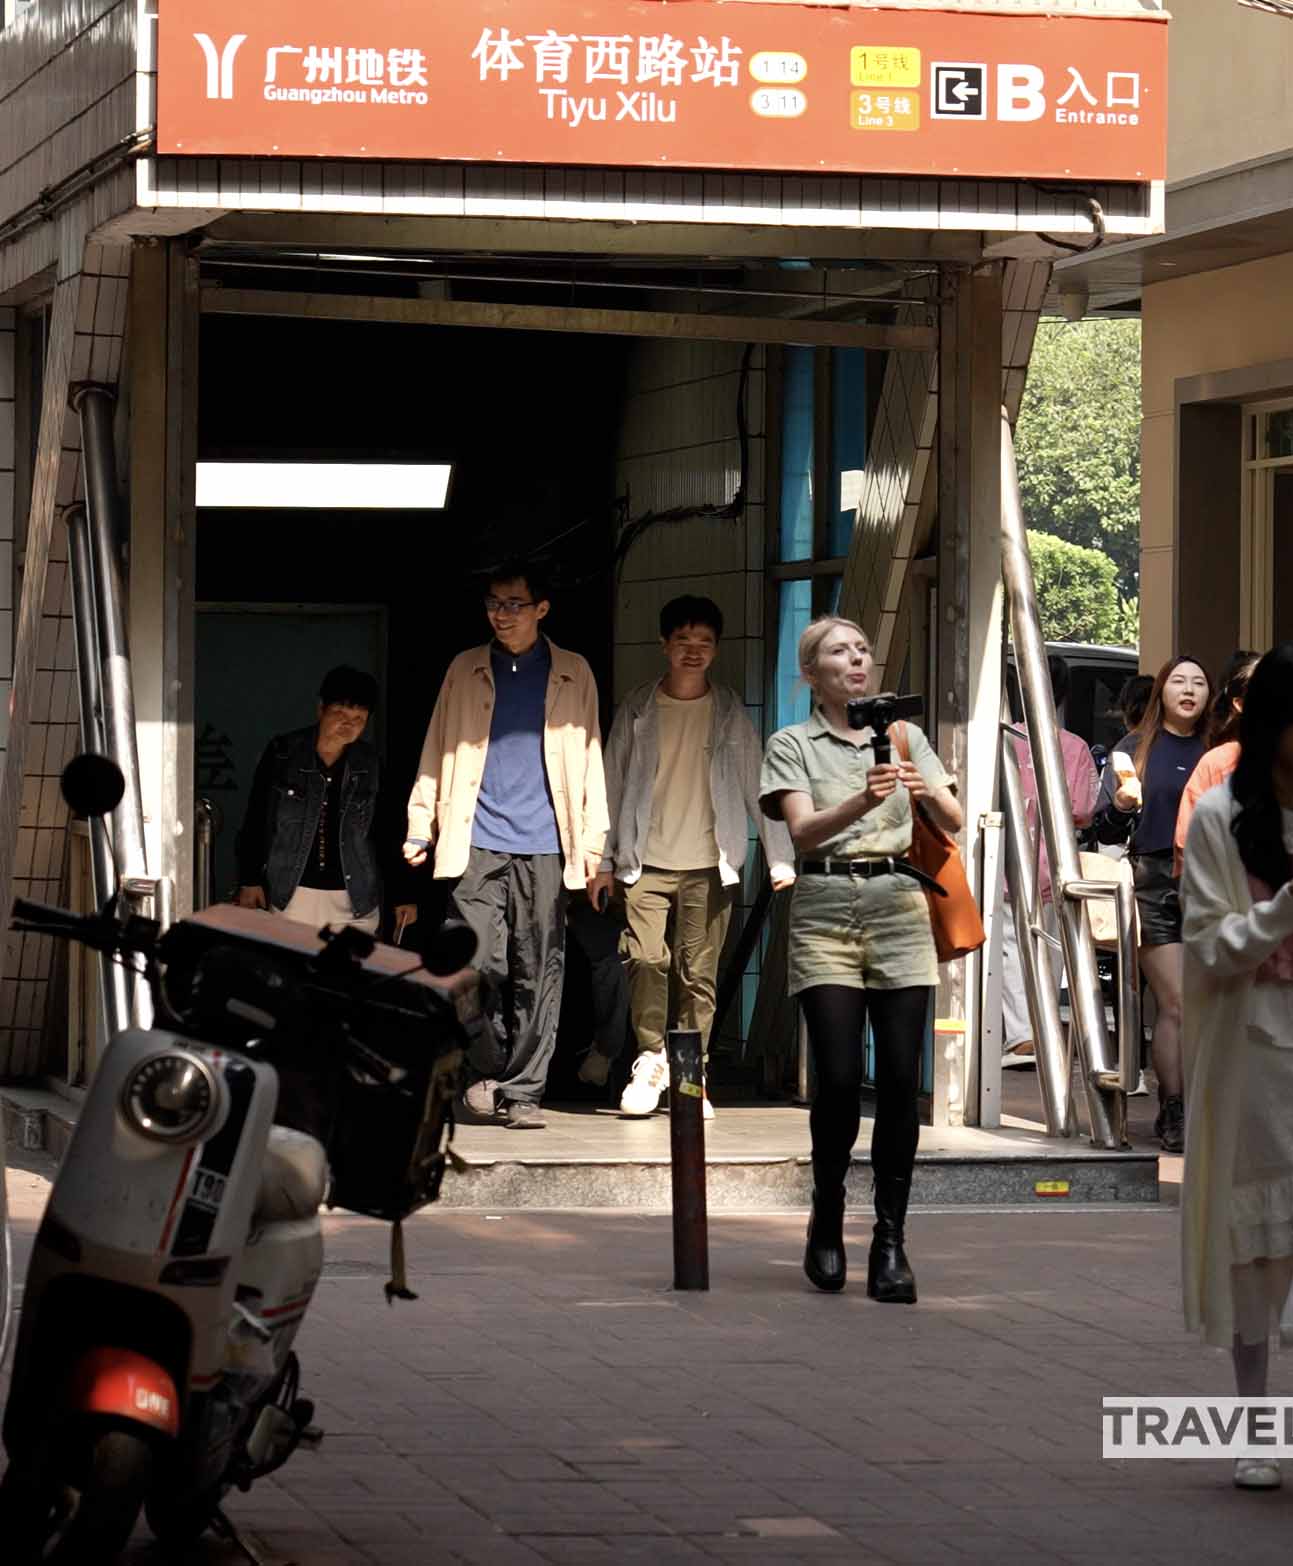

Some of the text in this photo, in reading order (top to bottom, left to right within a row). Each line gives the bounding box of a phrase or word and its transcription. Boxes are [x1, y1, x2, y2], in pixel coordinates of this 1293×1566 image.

[263, 45, 429, 87] 广州地铁
[471, 27, 744, 88] 体育西路站
[263, 84, 429, 105] Guangzhou Metro
[858, 94, 912, 115] 3号线
[996, 63, 1046, 122] B
[1056, 66, 1140, 108] 入口
[538, 88, 677, 128] Tiyu Xilu
[858, 115, 883, 126] Line
[1055, 108, 1139, 126] Entrance
